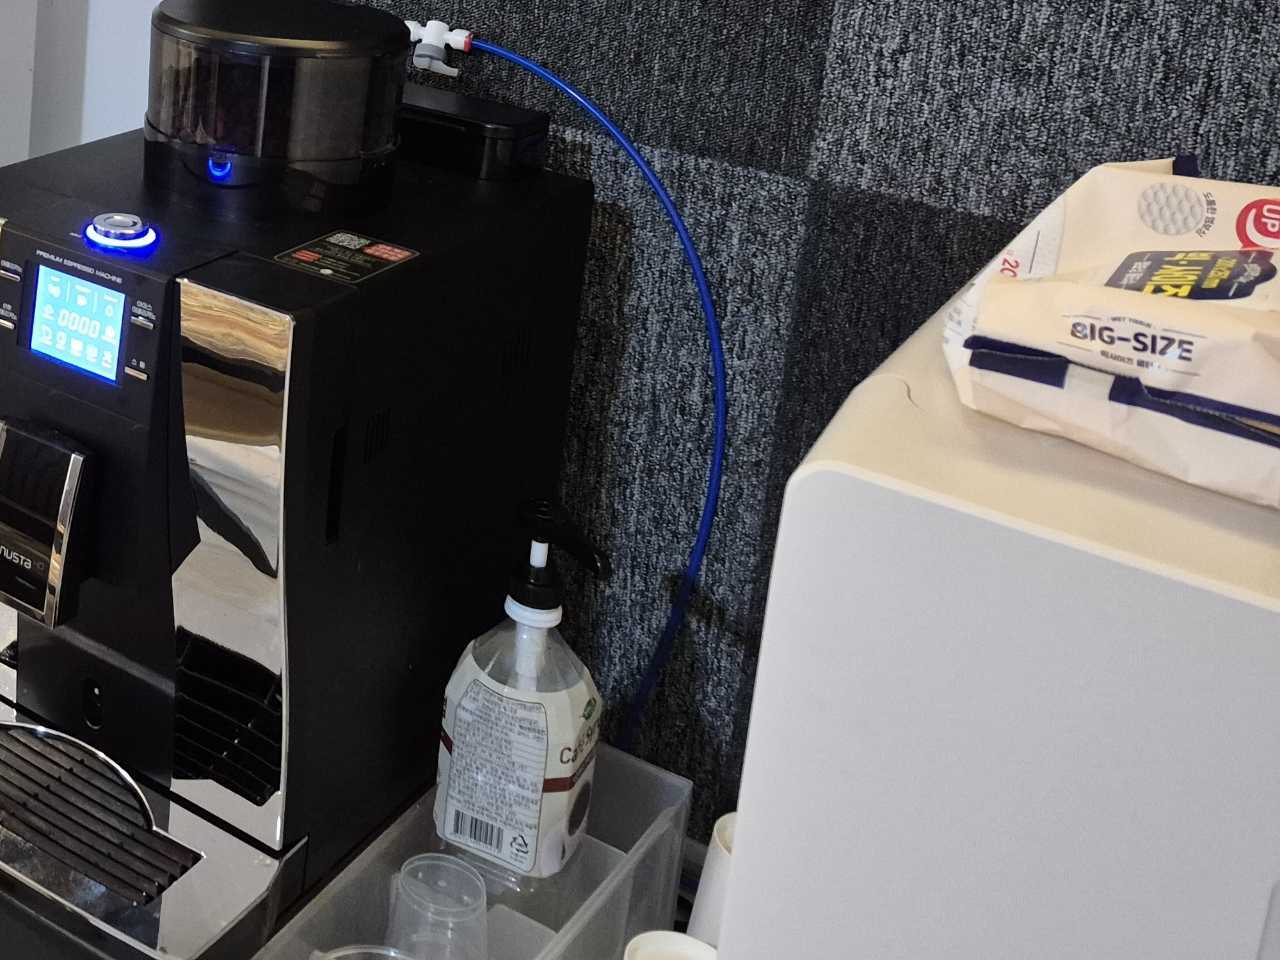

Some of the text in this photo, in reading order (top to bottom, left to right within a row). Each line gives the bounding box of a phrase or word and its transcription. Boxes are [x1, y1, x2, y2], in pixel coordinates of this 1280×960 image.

[36, 249, 123, 284] PREMIUM ESPRESSO MACHINE
[57, 308, 101, 339] 0000
[1070, 321, 1195, 363] BIG-SIZE
